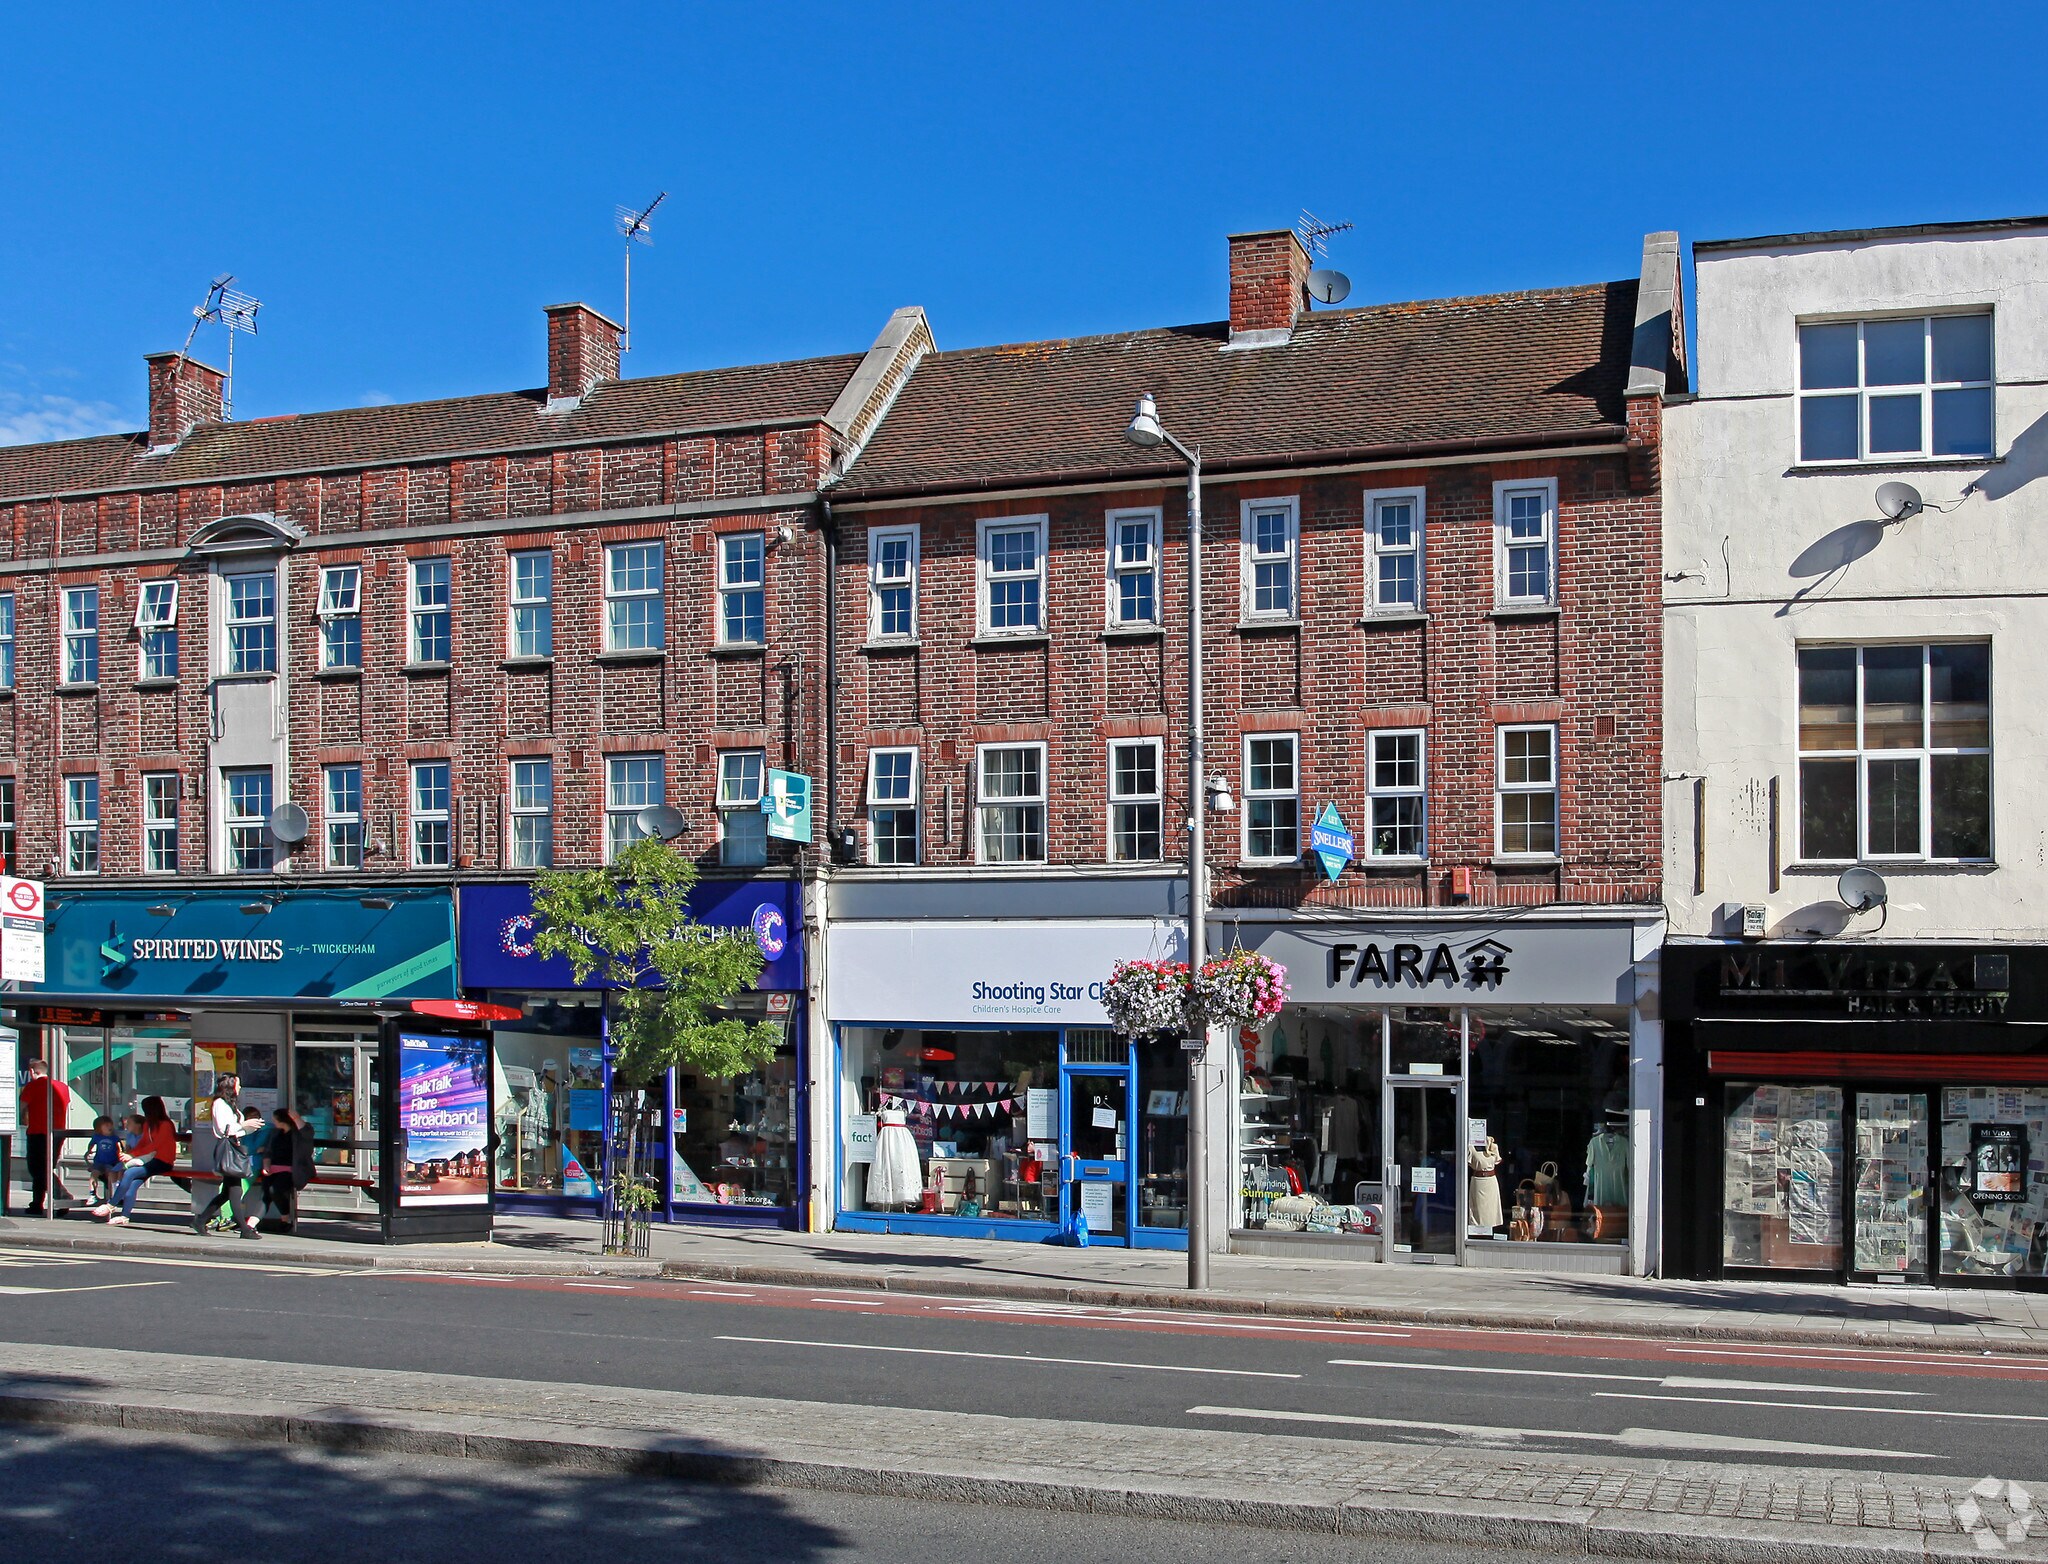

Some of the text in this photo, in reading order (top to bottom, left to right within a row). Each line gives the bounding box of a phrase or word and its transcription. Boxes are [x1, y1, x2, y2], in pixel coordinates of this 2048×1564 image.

[1313, 830, 1352, 854] SNELLERS
[133, 938, 283, 960] SPIRITED WINES
[312, 944, 376, 953] TWICKENHAM
[410, 962, 423, 975] good
[423, 956, 438, 967] times
[1333, 943, 1460, 983] FARA
[972, 981, 1045, 1005] Shooting
[1050, 982, 1084, 1000] Star
[972, 1005, 1009, 1013] Children's
[1011, 1005, 1042, 1015] Hospice
[1848, 997, 2008, 1014] HAIR & BEAUTY
[403, 1039, 428, 1048] TalkTalk
[411, 1075, 452, 1096] TalkTalk
[411, 1097, 437, 1111] Fibre
[410, 1107, 478, 1127] Broadband
[852, 1131, 872, 1142] fact
